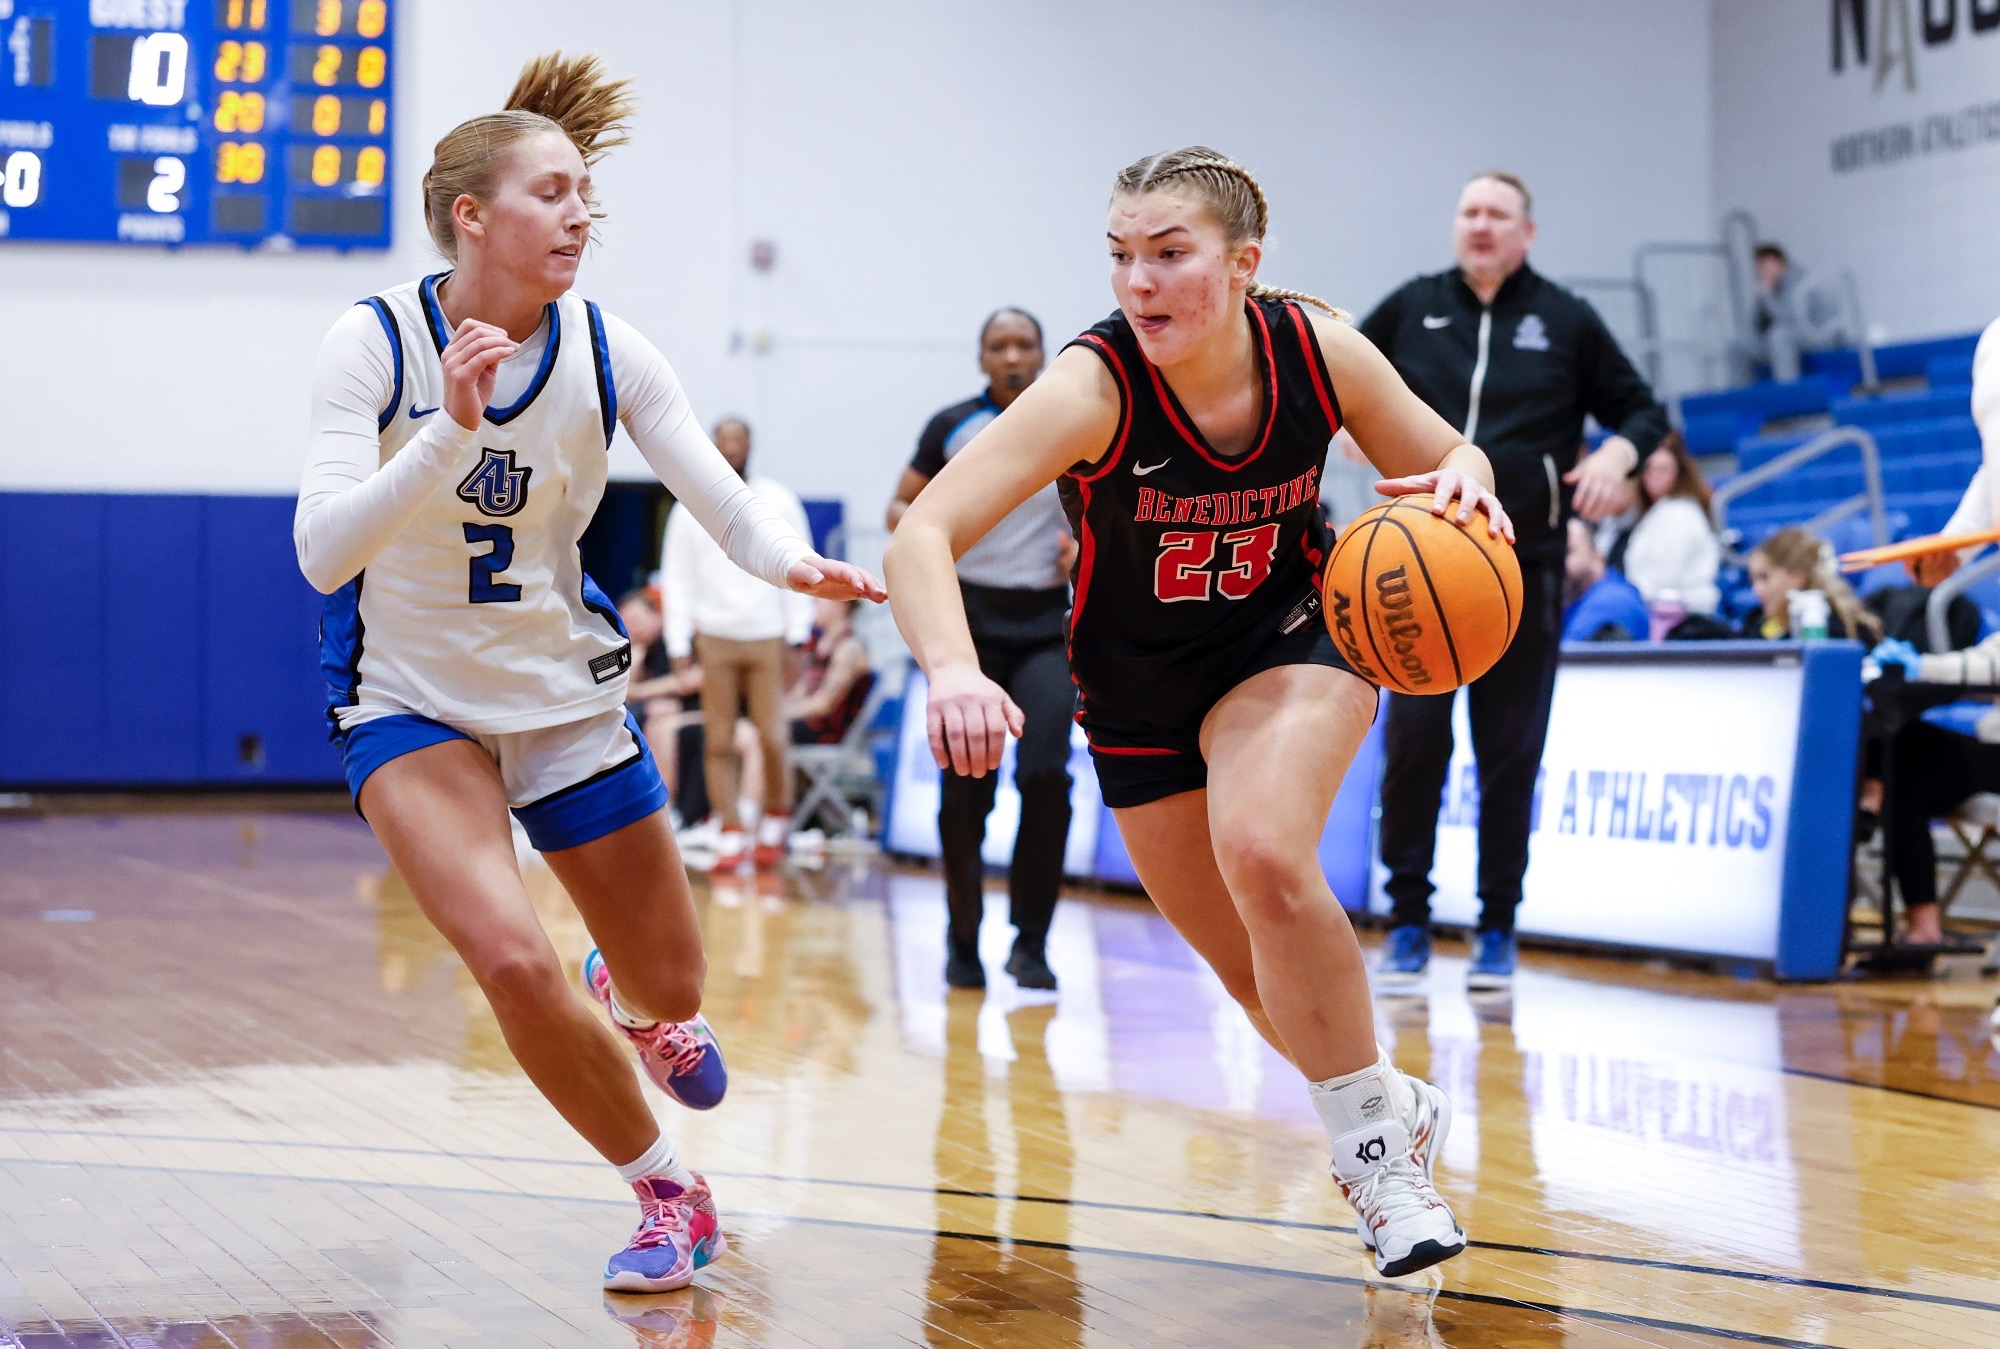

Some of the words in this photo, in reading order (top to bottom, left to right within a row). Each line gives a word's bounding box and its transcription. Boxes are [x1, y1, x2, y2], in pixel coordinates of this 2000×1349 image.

[128, 32, 188, 105] 10
[147, 157, 186, 213] 2
[1134, 465, 1318, 526] BENEDICTINE
[462, 522, 523, 603] 2
[1154, 523, 1281, 603] 23
[1307, 598, 1319, 610] M
[1375, 563, 1433, 687] Wilson
[1558, 769, 1774, 850] ATHLETICS
